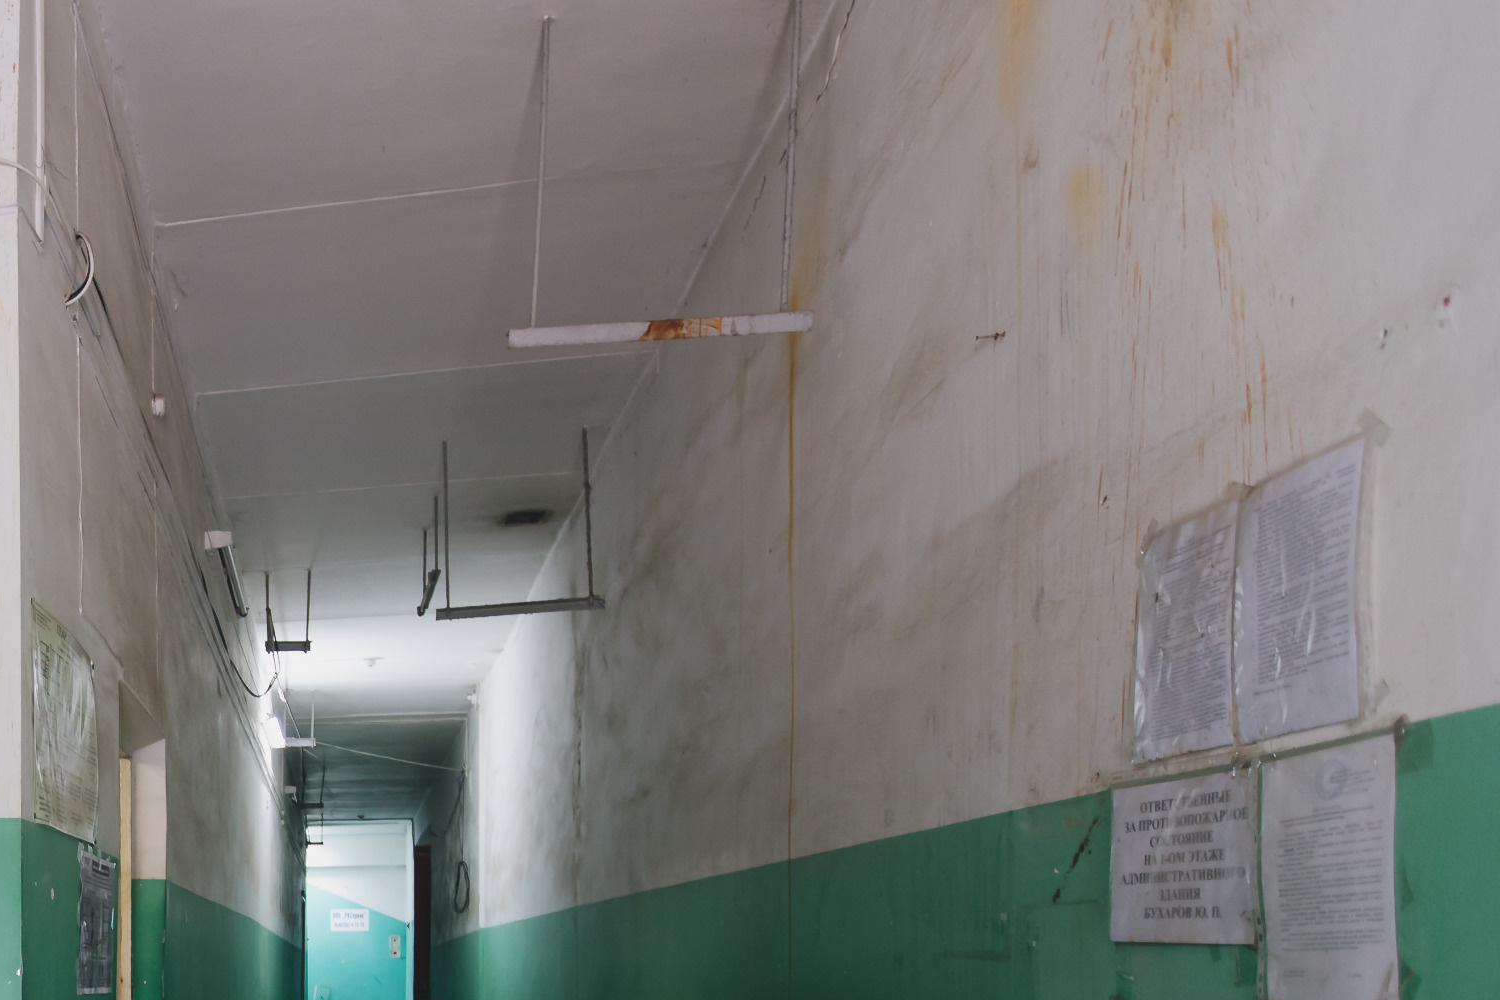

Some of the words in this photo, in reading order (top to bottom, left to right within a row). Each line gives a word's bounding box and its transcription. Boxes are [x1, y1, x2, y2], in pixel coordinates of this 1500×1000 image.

[1140, 790, 1232, 814] ОТВЕТТВЕННЫЕ
[1124, 821, 1137, 833] ЗА
[1139, 807, 1248, 832] ПРОТВОПОЖАРОЕ
[1149, 830, 1214, 848] СОТОЯНИЕ
[1144, 853, 1157, 866] НА
[1189, 848, 1226, 864] ЭТАЖЕ
[1160, 888, 1201, 901] ЗДАНИЯ
[1144, 906, 1191, 919] БУХАРОВ
